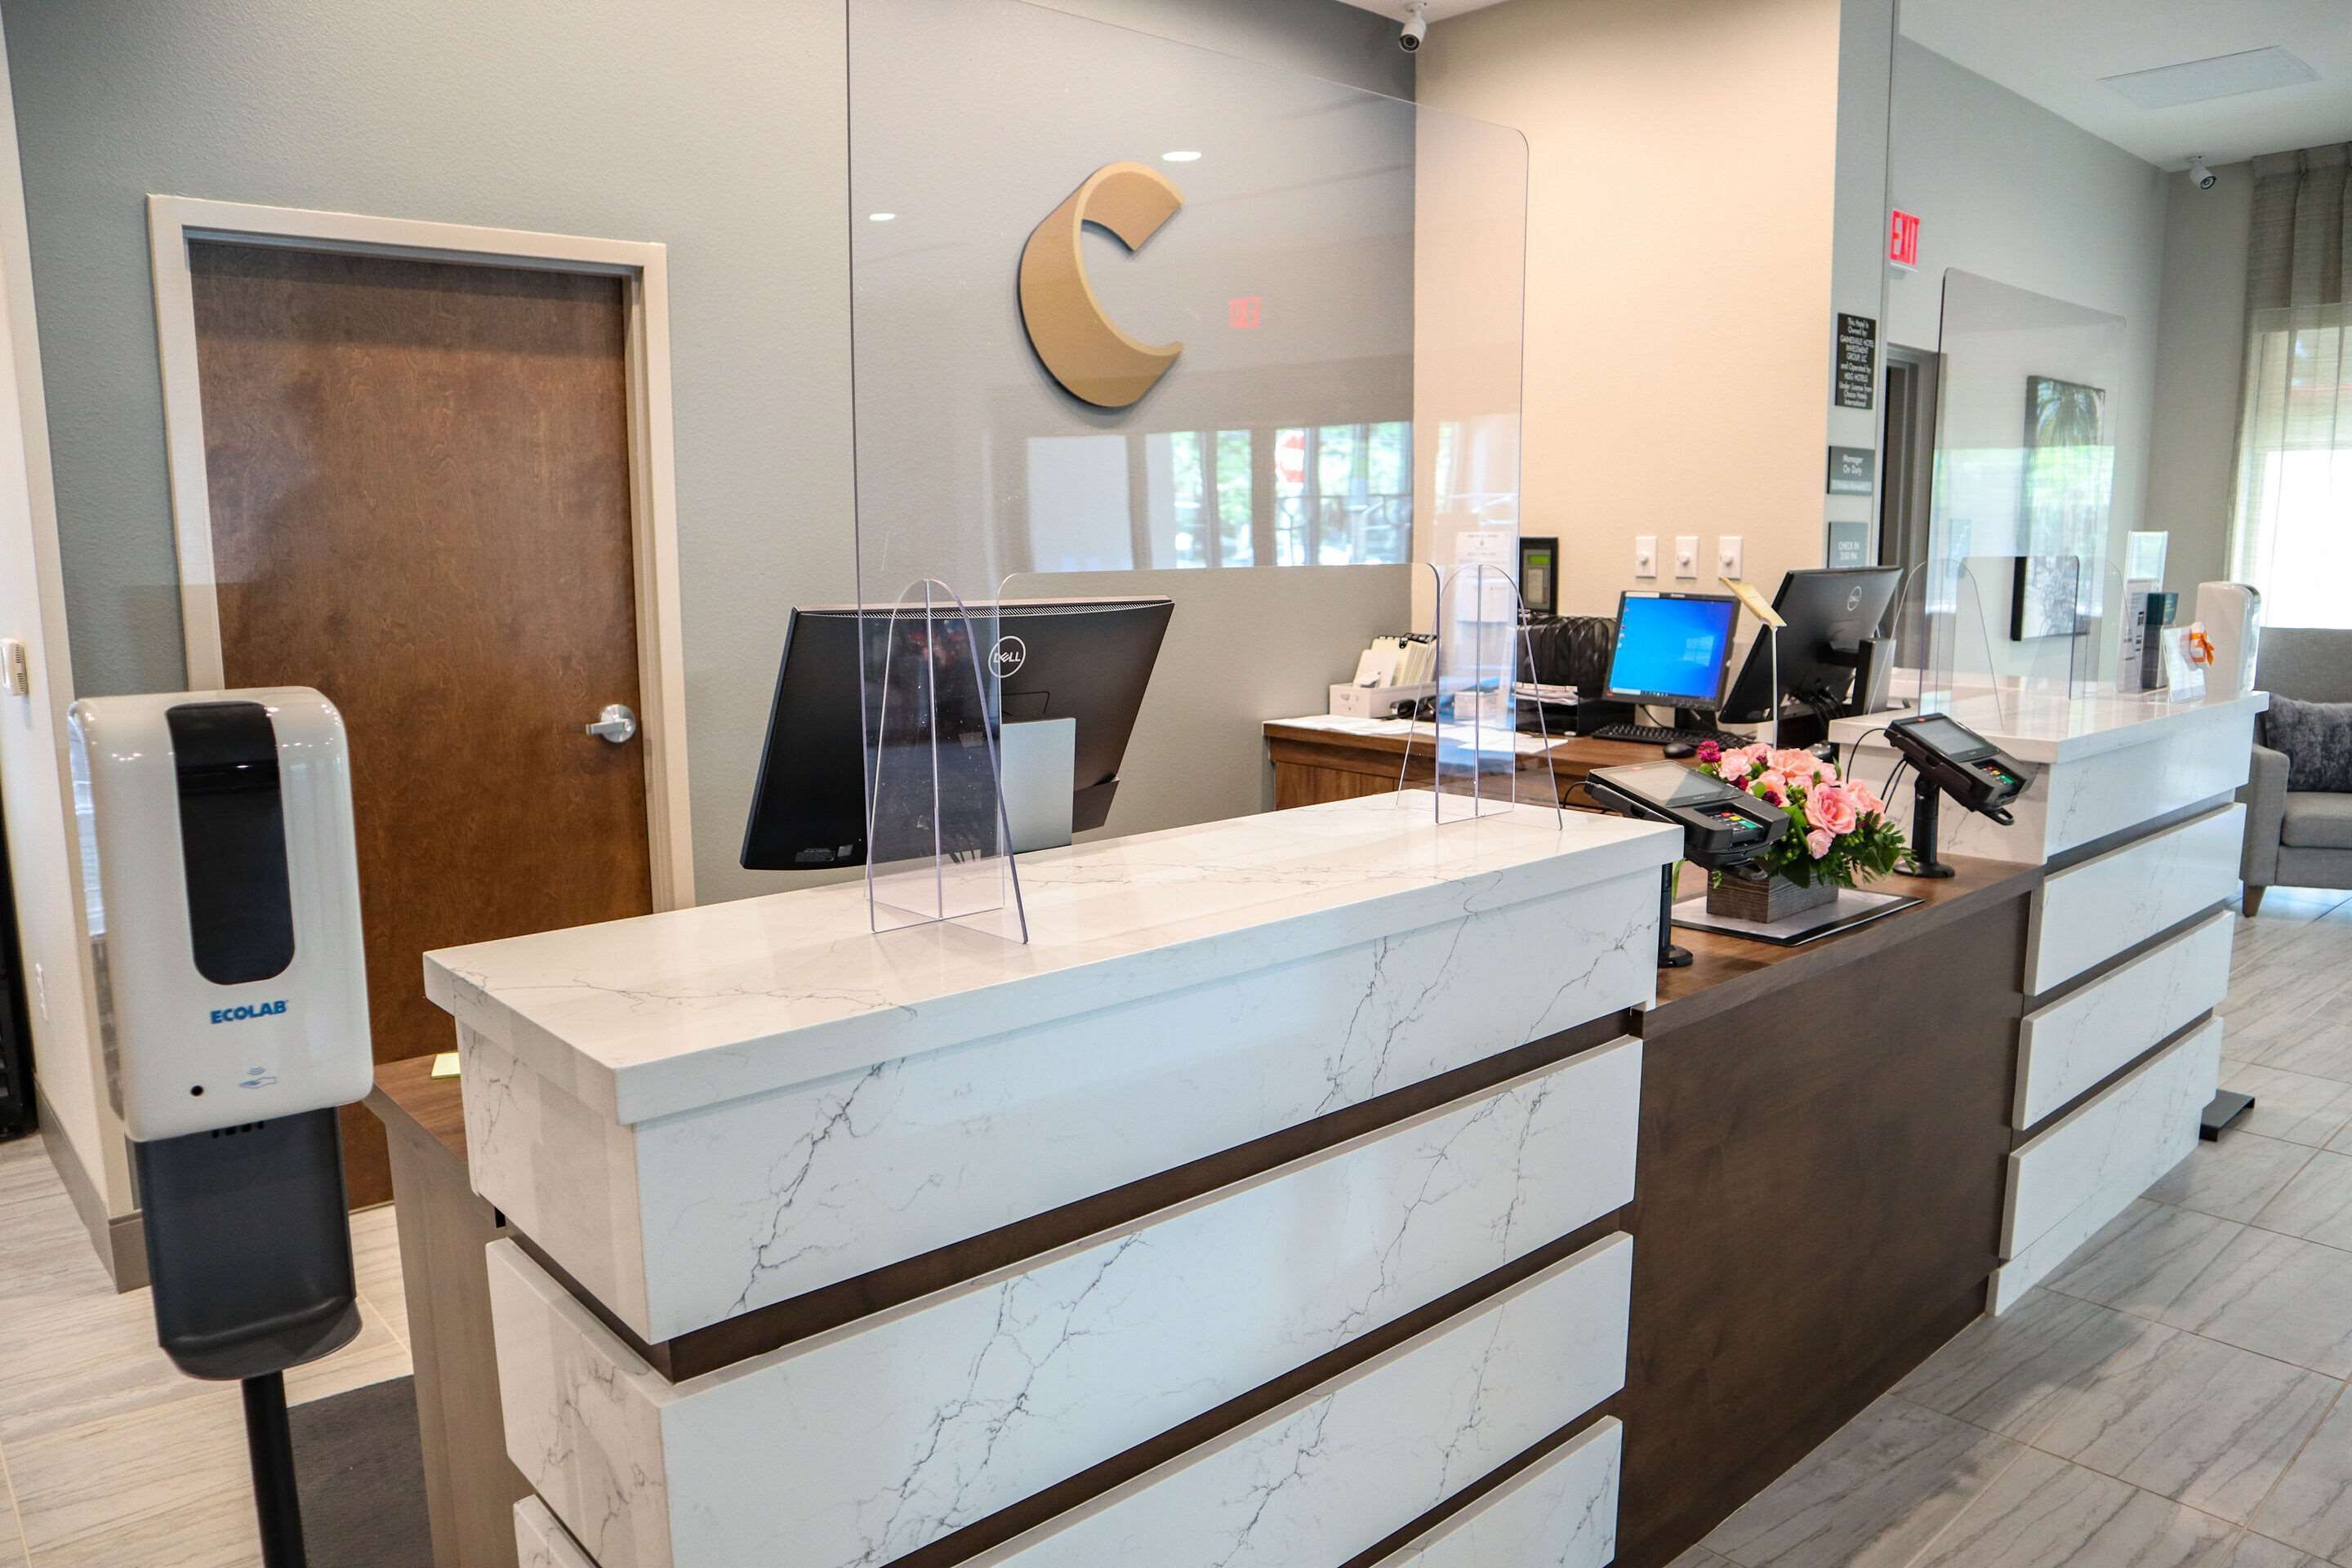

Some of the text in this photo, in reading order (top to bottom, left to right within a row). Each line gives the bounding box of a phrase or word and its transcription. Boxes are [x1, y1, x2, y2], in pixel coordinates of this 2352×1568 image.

[1890, 209, 1921, 265] EXIT
[1842, 454, 1863, 466] Manager
[1842, 464, 1862, 476] On Duty
[1838, 541, 1853, 550] CHECK
[993, 651, 1021, 663] DELL
[210, 1000, 287, 1025] ECOLAB
